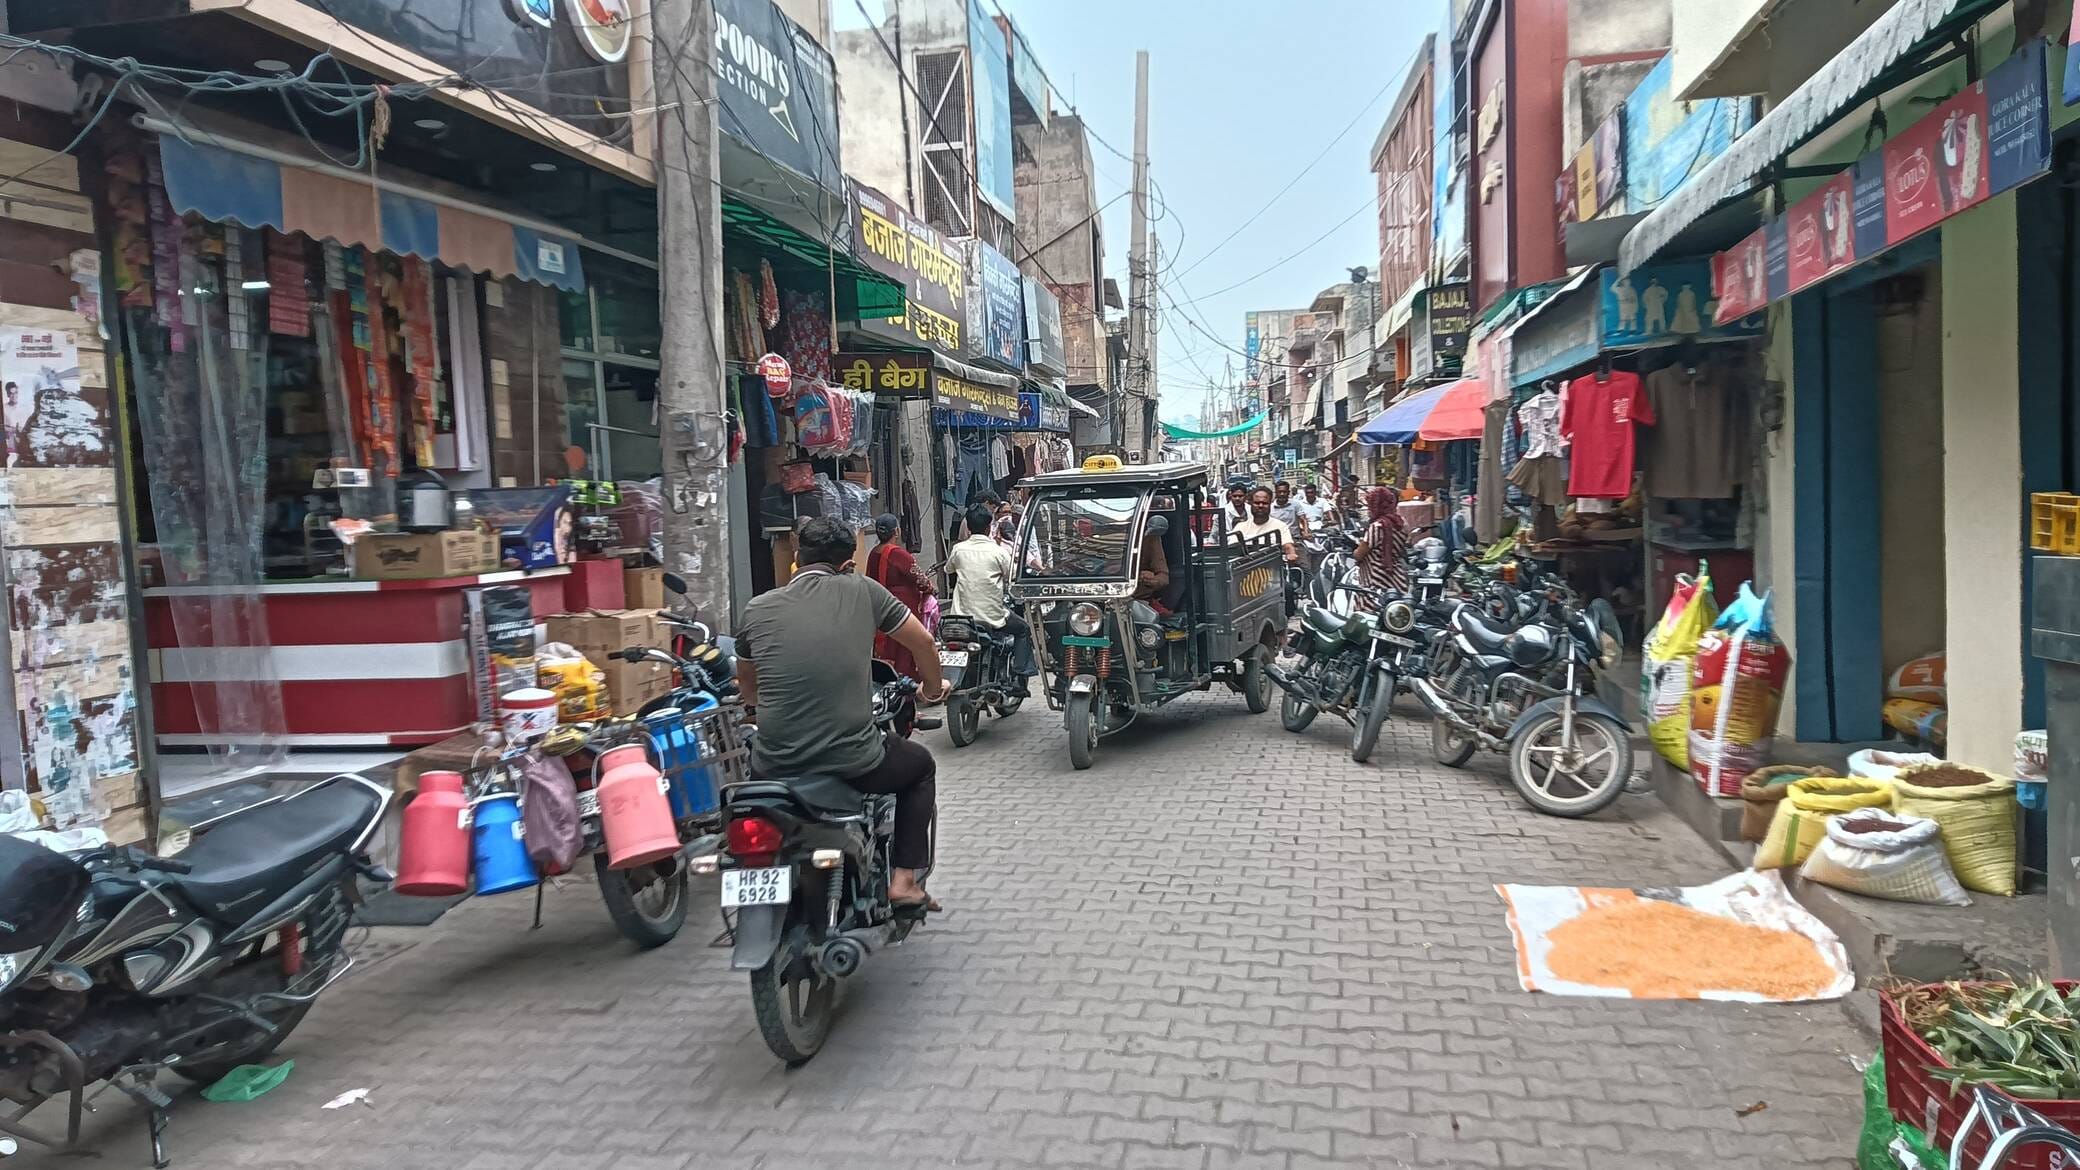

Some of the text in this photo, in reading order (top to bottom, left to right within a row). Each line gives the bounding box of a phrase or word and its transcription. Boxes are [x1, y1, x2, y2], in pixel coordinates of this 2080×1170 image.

[1897, 162, 1927, 194] LOTUS
[861, 207, 909, 270] बजाज
[1432, 290, 1466, 310] BAJAJ
[842, 360, 928, 391] ही बैग
[1042, 587, 1066, 595] CITY
[739, 869, 780, 887] HR 92
[738, 886, 777, 903] 6928
